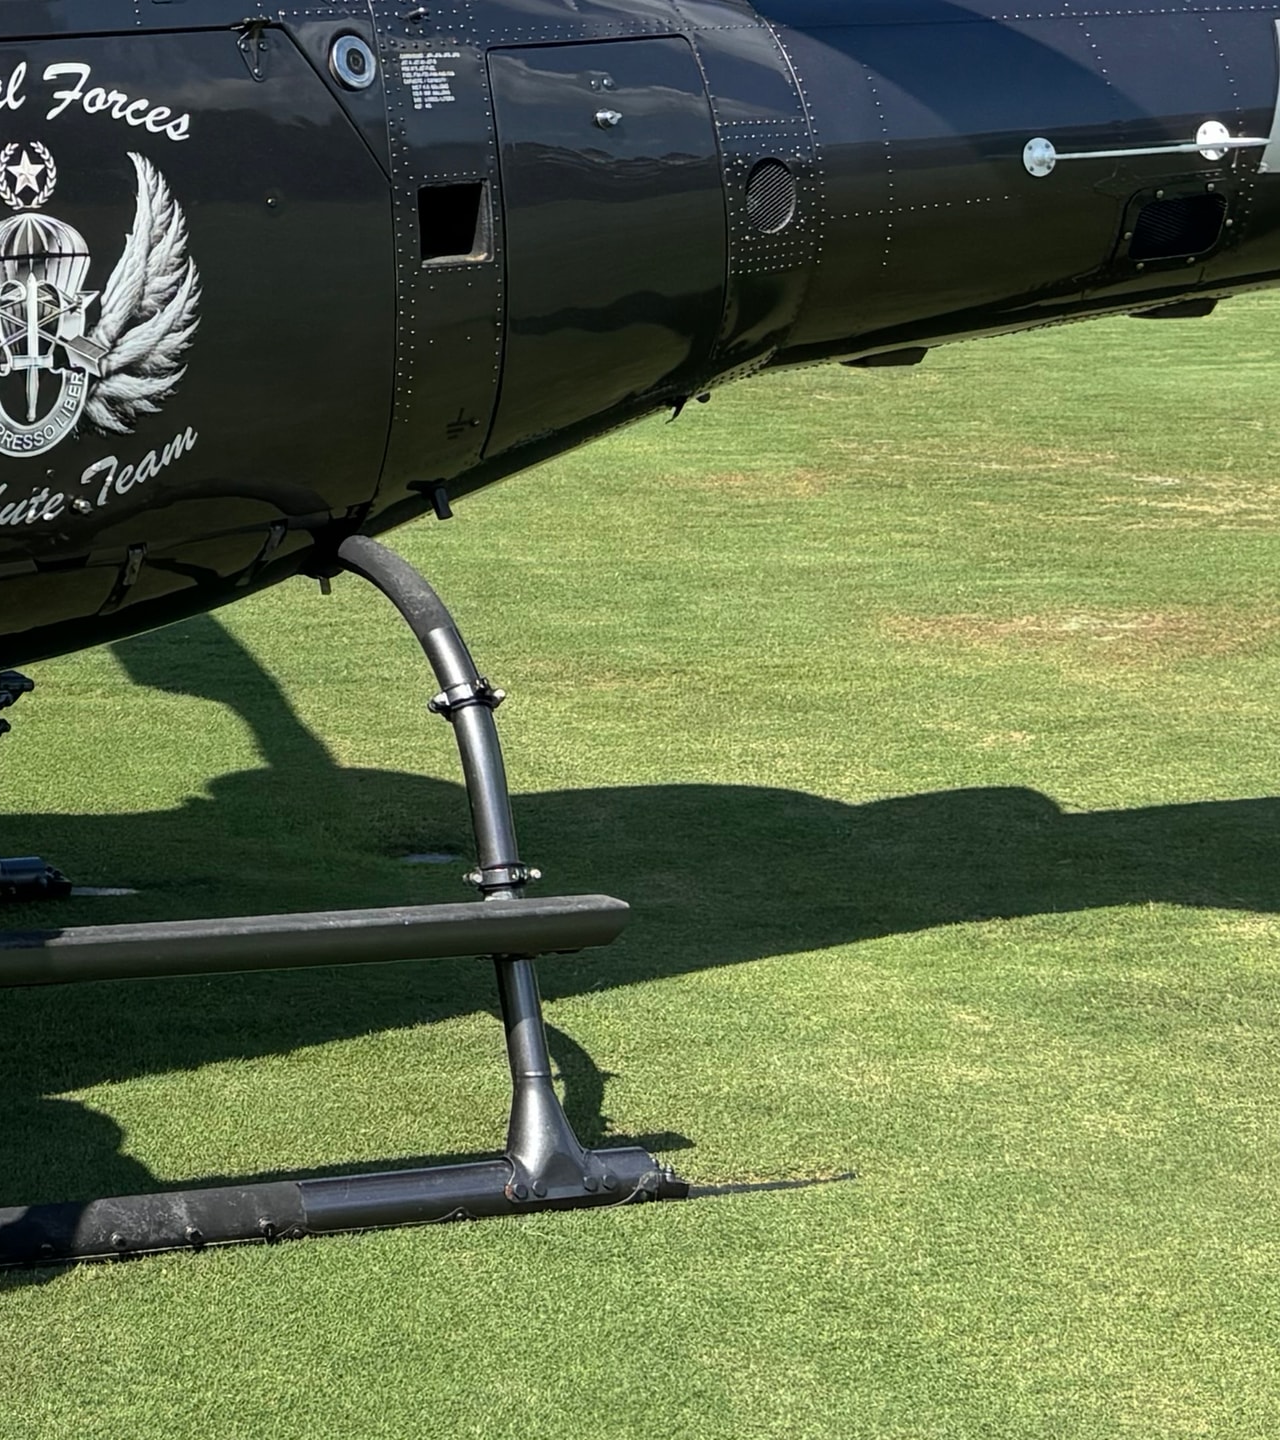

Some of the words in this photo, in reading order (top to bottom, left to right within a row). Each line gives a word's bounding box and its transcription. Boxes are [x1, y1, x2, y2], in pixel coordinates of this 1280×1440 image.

[43, 62, 190, 141] Forces
[54, 372, 84, 429] LIBER
[81, 426, 198, 506] Team
